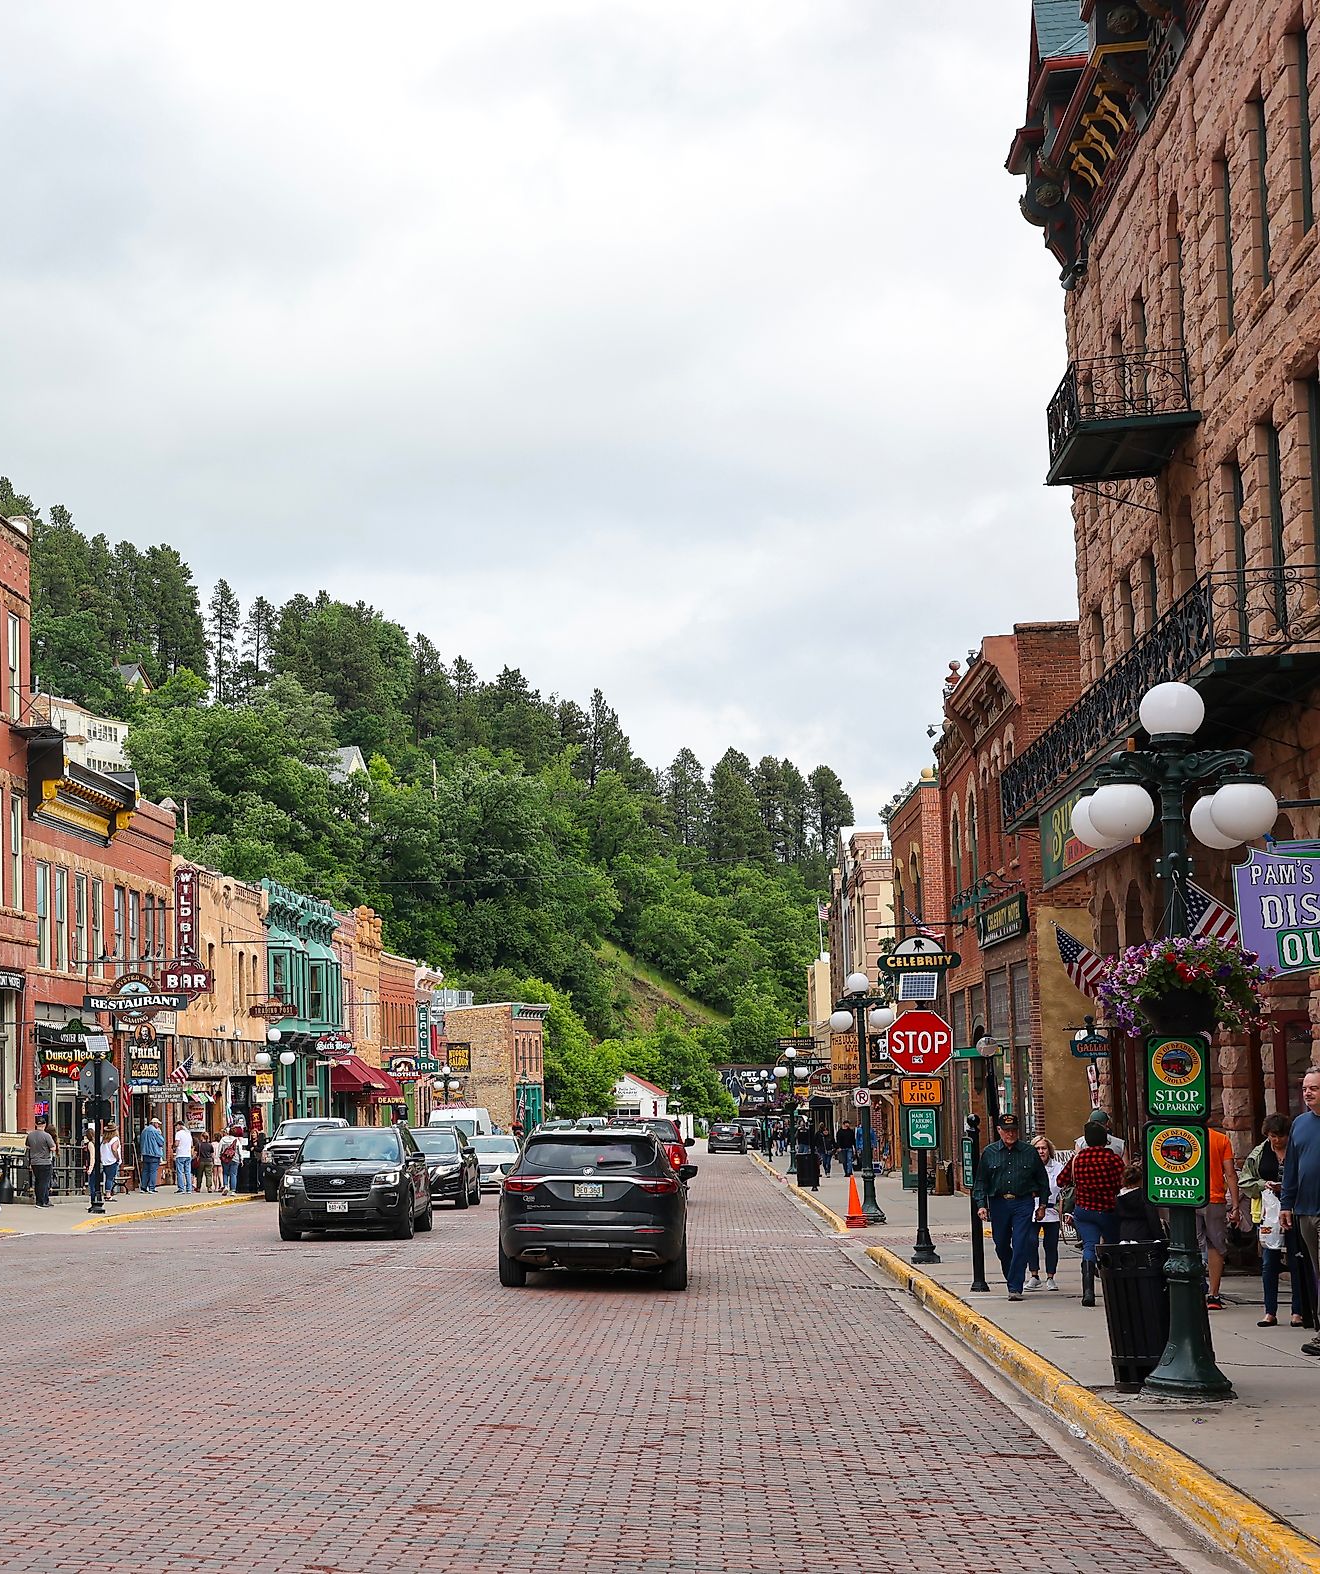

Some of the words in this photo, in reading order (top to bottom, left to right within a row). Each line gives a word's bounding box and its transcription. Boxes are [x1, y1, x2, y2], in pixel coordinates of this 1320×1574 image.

[1250, 859, 1314, 886] PAM'S
[180, 872, 192, 917] WILD
[886, 955, 953, 968] CELEBRITY
[116, 974, 140, 989] OYSTER
[166, 973, 207, 989] BAR
[90, 995, 180, 1010] RESTAURANT
[279, 1006, 293, 1014] POST
[122, 1014, 149, 1024] GAMING
[419, 1012, 427, 1058] EAGLE
[315, 1041, 335, 1050] Sick
[335, 1041, 352, 1051] Boy
[891, 1030, 949, 1054] STOP
[73, 1048, 106, 1062] Nells
[129, 1046, 161, 1060] TRIAL
[1171, 1042, 1199, 1065] DEADWOOD
[46, 1063, 69, 1074] IRISH
[833, 1063, 857, 1071] SHILOH
[910, 1081, 933, 1091] PED
[1163, 1075, 1191, 1084] TROLLEY
[909, 1092, 935, 1102] XING
[1155, 1089, 1199, 1102] STOP
[1153, 1102, 1165, 1111] NO
[1166, 1102, 1203, 1111] PARKING
[1170, 1130, 1198, 1152] DEADWOOD
[1162, 1162, 1191, 1171] TROLLEY
[1154, 1176, 1200, 1187] BOARD
[1159, 1188, 1196, 1199] HERE
